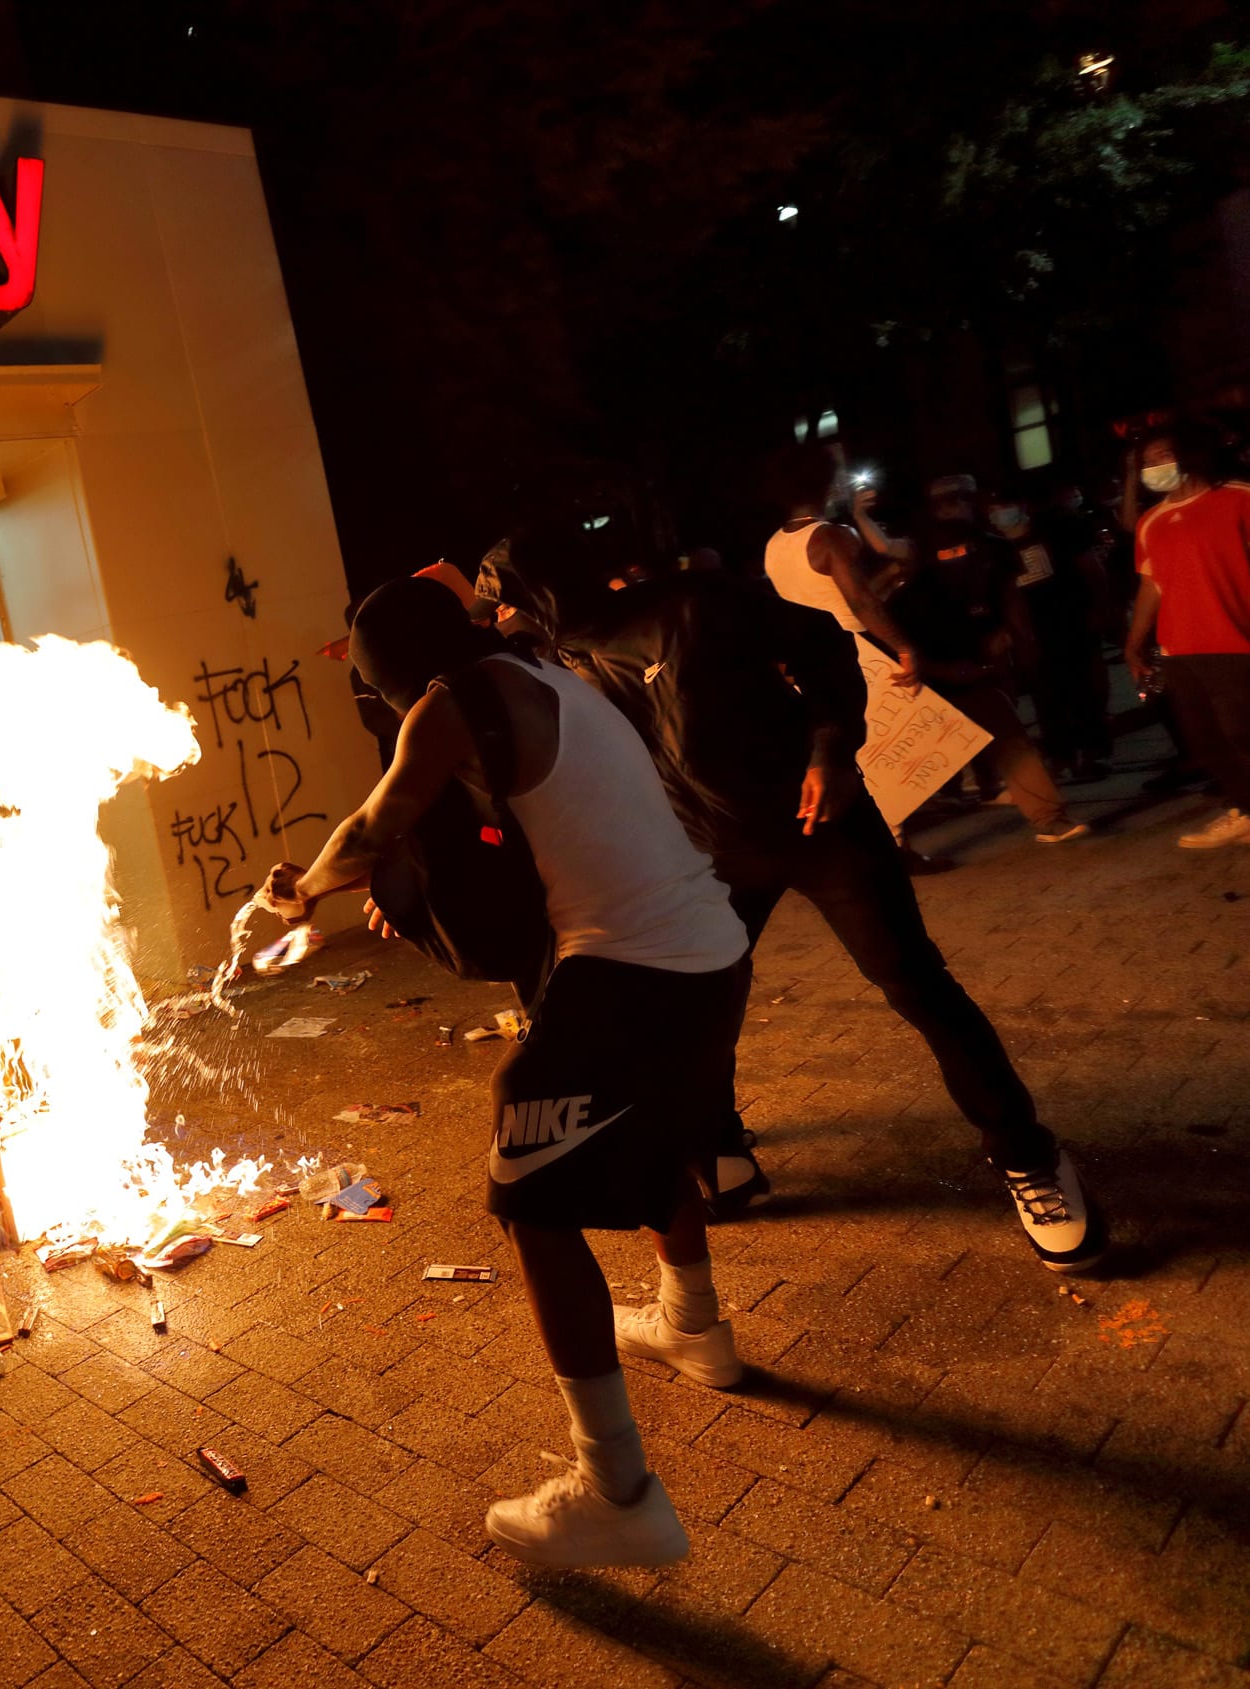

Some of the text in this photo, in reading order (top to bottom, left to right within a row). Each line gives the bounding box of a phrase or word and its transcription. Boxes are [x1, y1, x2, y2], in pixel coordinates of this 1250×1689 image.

[238, 740, 327, 838] 12
[171, 802, 246, 865] FUCK
[193, 856, 254, 910] 12
[499, 1094, 593, 1149] NIKE
